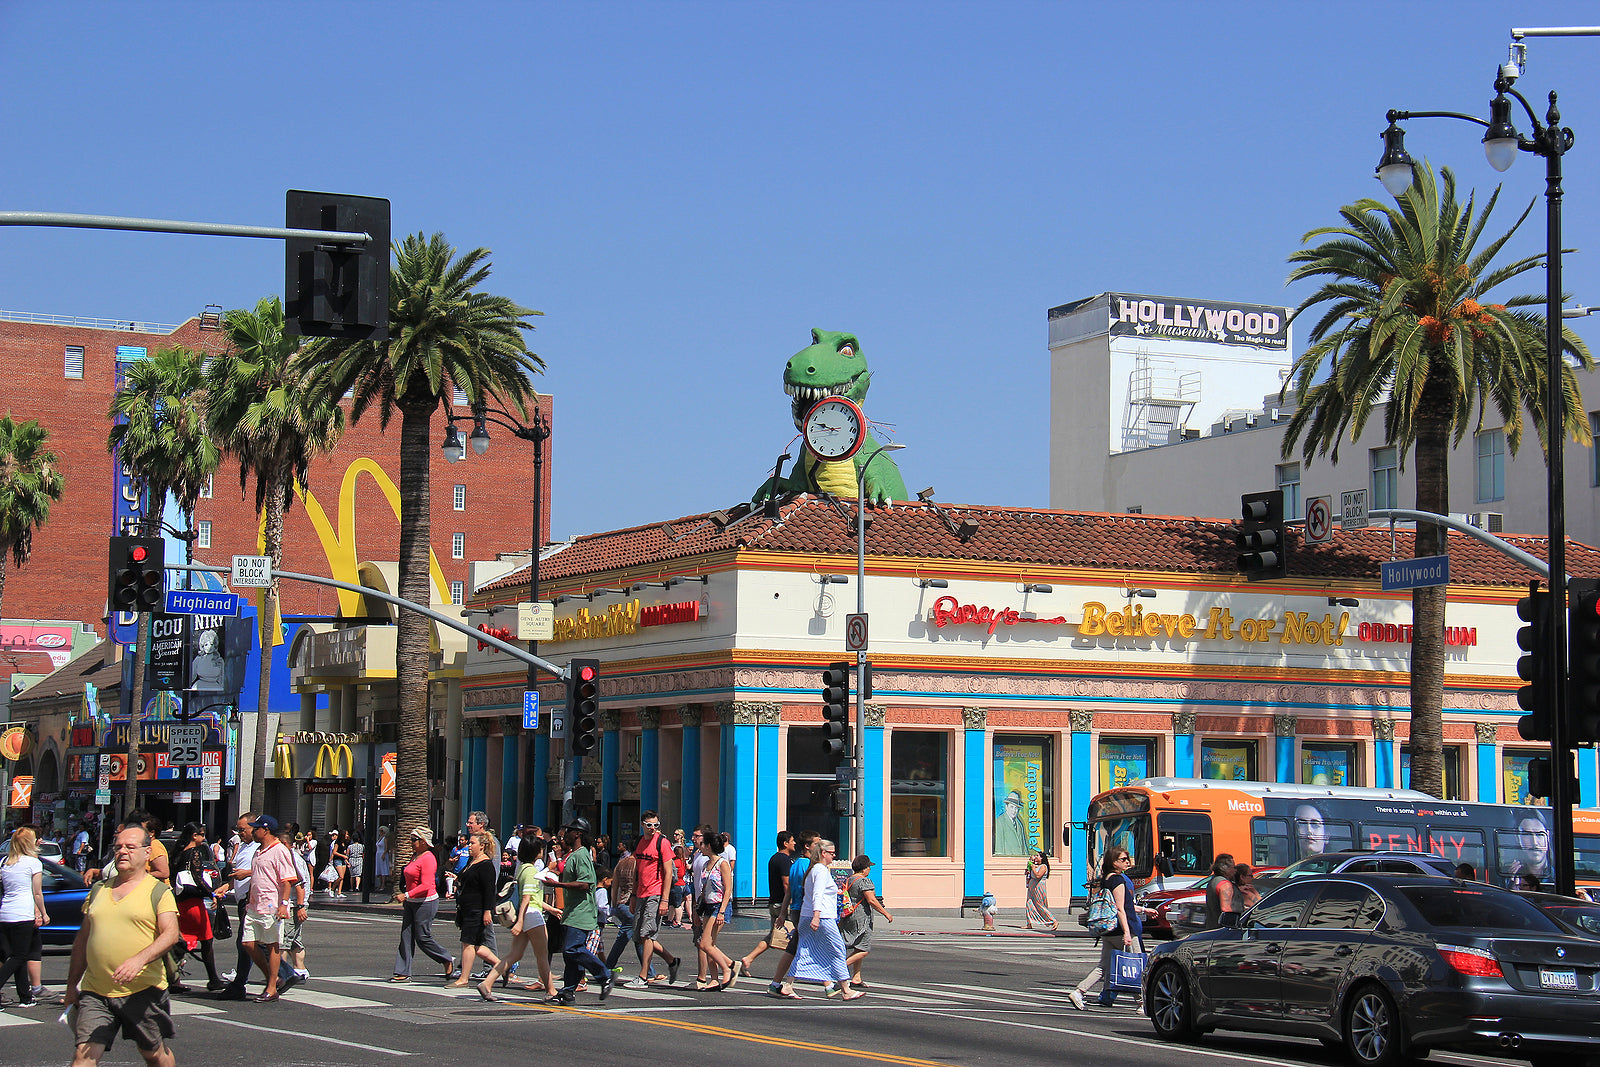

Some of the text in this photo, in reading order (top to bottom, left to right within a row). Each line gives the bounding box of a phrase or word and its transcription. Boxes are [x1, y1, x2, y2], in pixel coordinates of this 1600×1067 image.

[1119, 299, 1280, 336] HOLLYWOOD
[1150, 323, 1212, 339] Museum
[1234, 334, 1245, 342] The
[1245, 335, 1264, 344] Magic
[1343, 493, 1364, 506] DO NOT
[1345, 505, 1363, 518] BLOCK
[237, 558, 266, 568] DO NOT
[239, 568, 264, 578] BLOCK
[1388, 564, 1442, 584] Hollywood
[233, 577, 269, 585] INTERSECTION
[173, 595, 231, 611] Highland
[153, 617, 183, 637] COU
[1078, 601, 1196, 639] Believe
[1203, 607, 1234, 640] It
[1240, 616, 1276, 643] or
[1280, 611, 1350, 646] Not!
[170, 728, 201, 736] SPEED
[173, 737, 198, 745] LIMIT
[171, 746, 199, 762] 25
[1510, 773, 1522, 804] Fan
[1024, 761, 1041, 852] Impossible!
[1227, 799, 1262, 812] Metro
[1122, 965, 1137, 979] GAP
